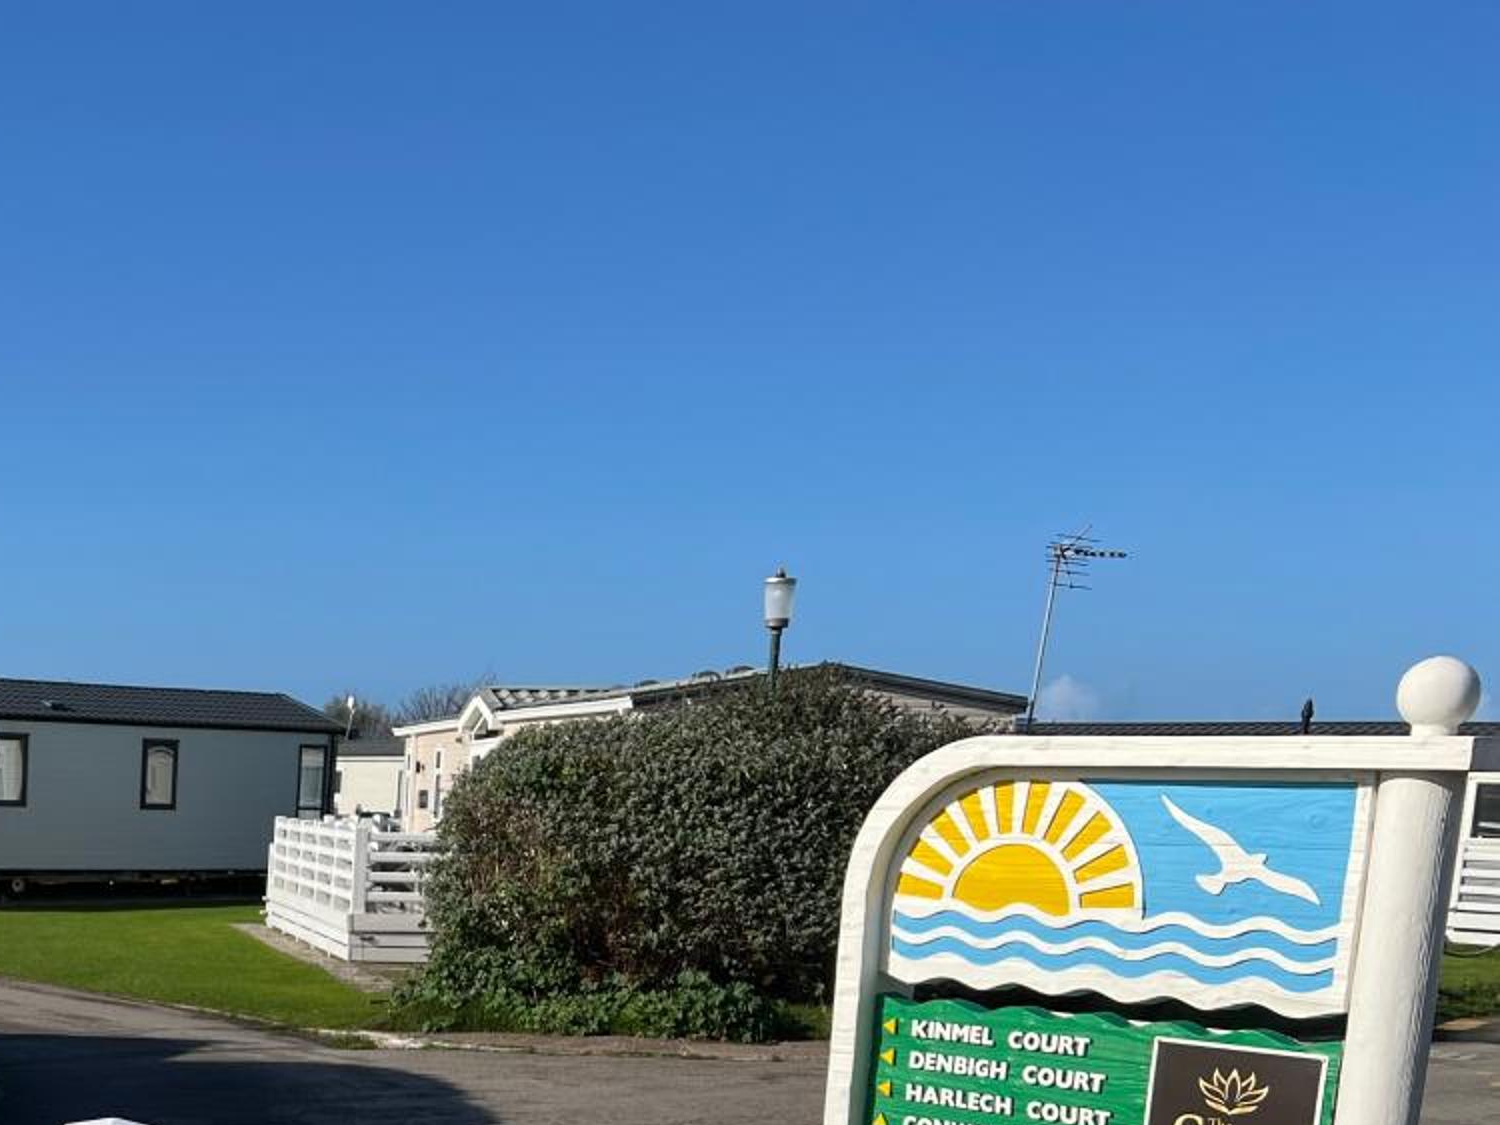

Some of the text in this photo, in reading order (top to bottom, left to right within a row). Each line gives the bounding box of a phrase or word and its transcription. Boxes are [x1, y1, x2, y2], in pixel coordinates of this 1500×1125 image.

[911, 1019, 1091, 1057] KINMEL COURT
[908, 1050, 1107, 1094] DENBIGH COURT
[905, 1083, 1013, 1115] HARLECH
